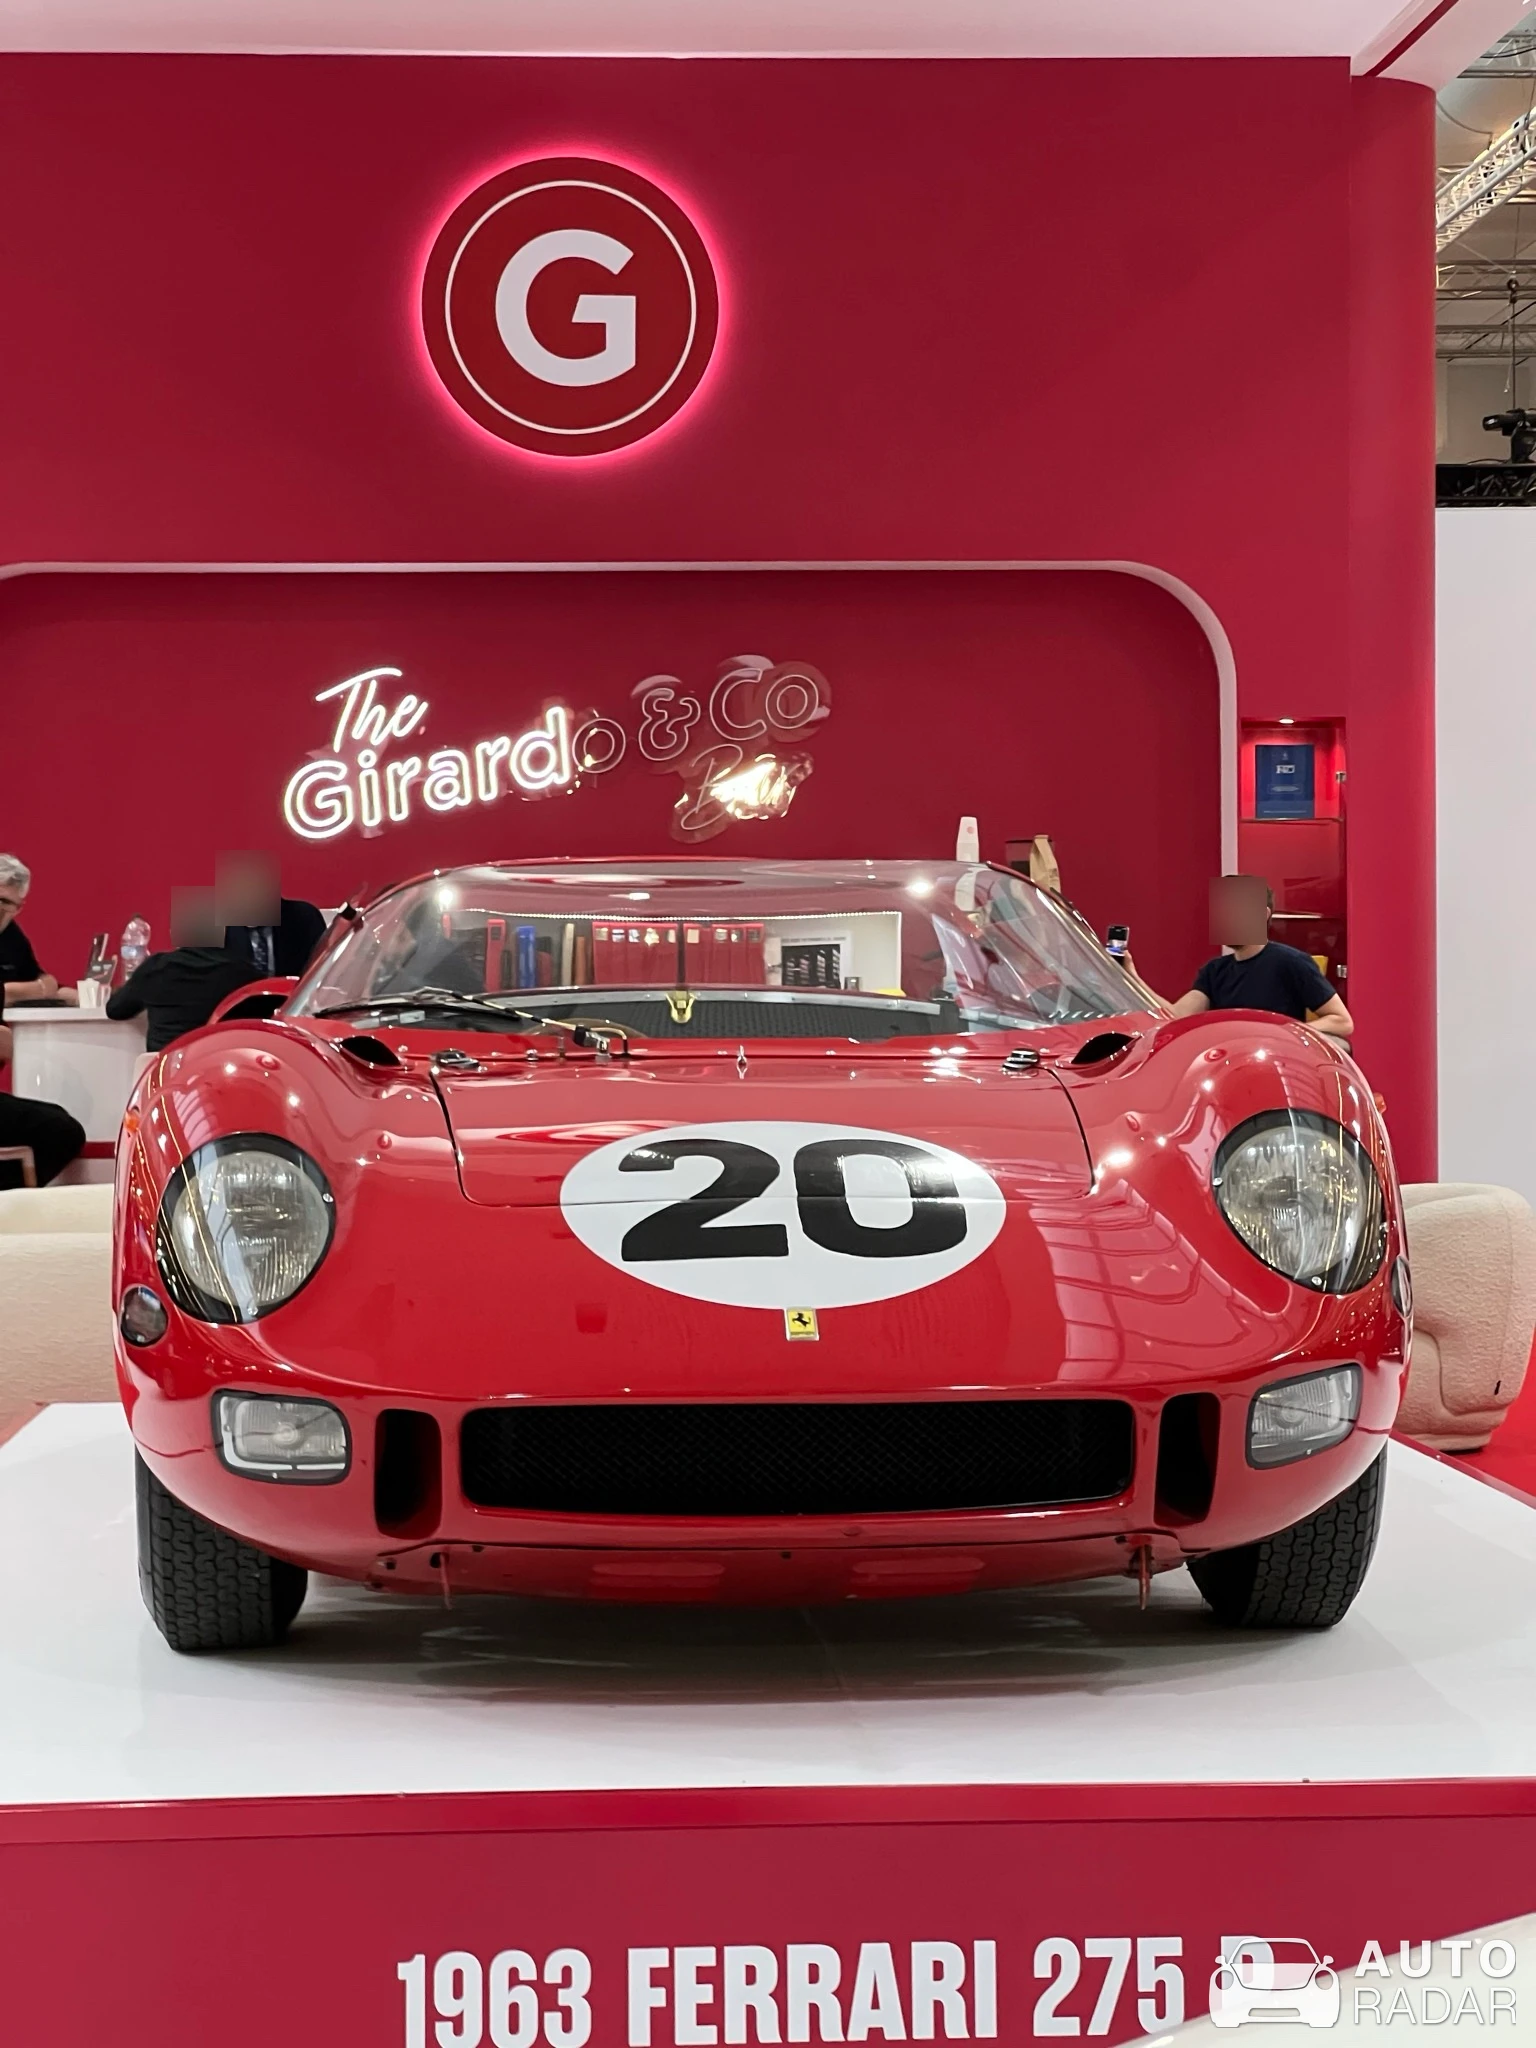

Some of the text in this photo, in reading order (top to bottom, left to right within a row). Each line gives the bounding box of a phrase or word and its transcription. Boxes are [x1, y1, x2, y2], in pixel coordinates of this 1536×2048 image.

[495, 228, 637, 387] G
[284, 705, 626, 839] Girardo
[639, 687, 701, 761] &
[314, 667, 429, 753] The
[618, 1138, 968, 1262] 20
[397, 1948, 592, 2048] 1963
[628, 1940, 998, 2047] FERRARI
[1033, 1937, 1185, 2036] 275
